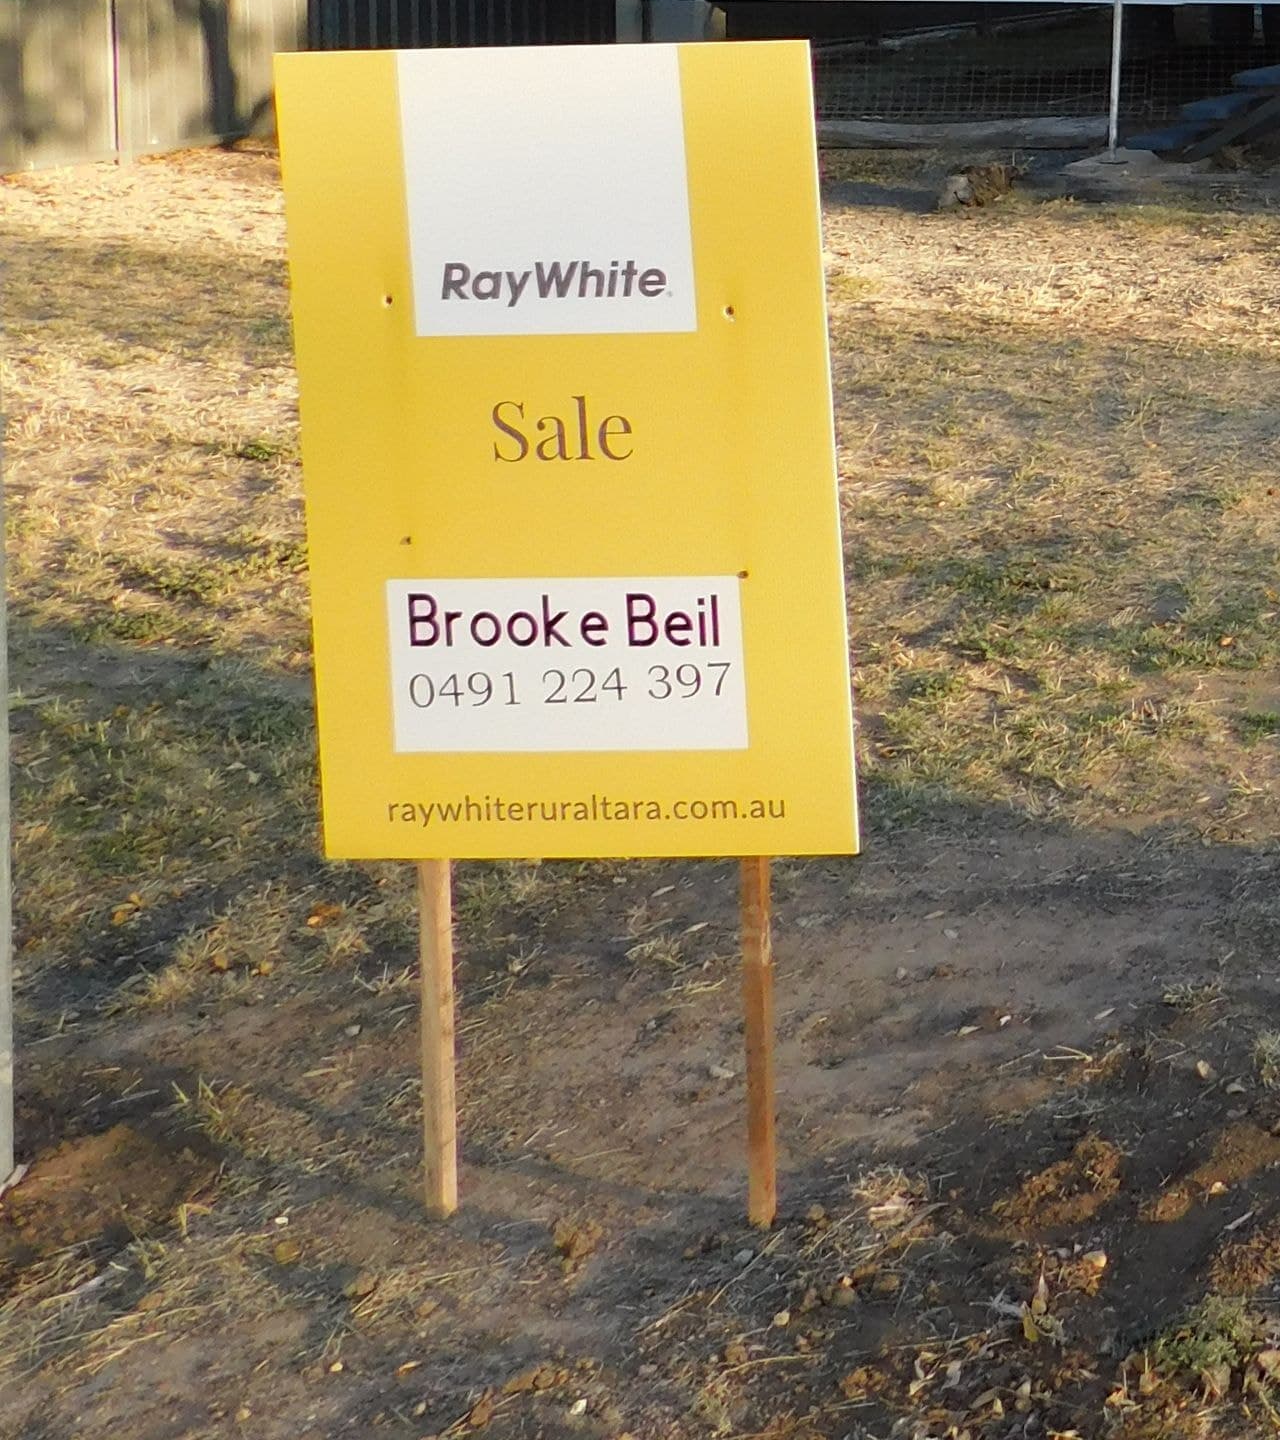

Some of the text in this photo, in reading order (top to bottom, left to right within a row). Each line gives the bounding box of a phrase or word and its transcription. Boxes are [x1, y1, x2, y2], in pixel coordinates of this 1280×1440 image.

[492, 395, 634, 463] Sale
[407, 593, 720, 647] Brooke Beil
[408, 662, 731, 708] 0491 224 397
[388, 794, 786, 828] raywhiteruraltara.com.au
